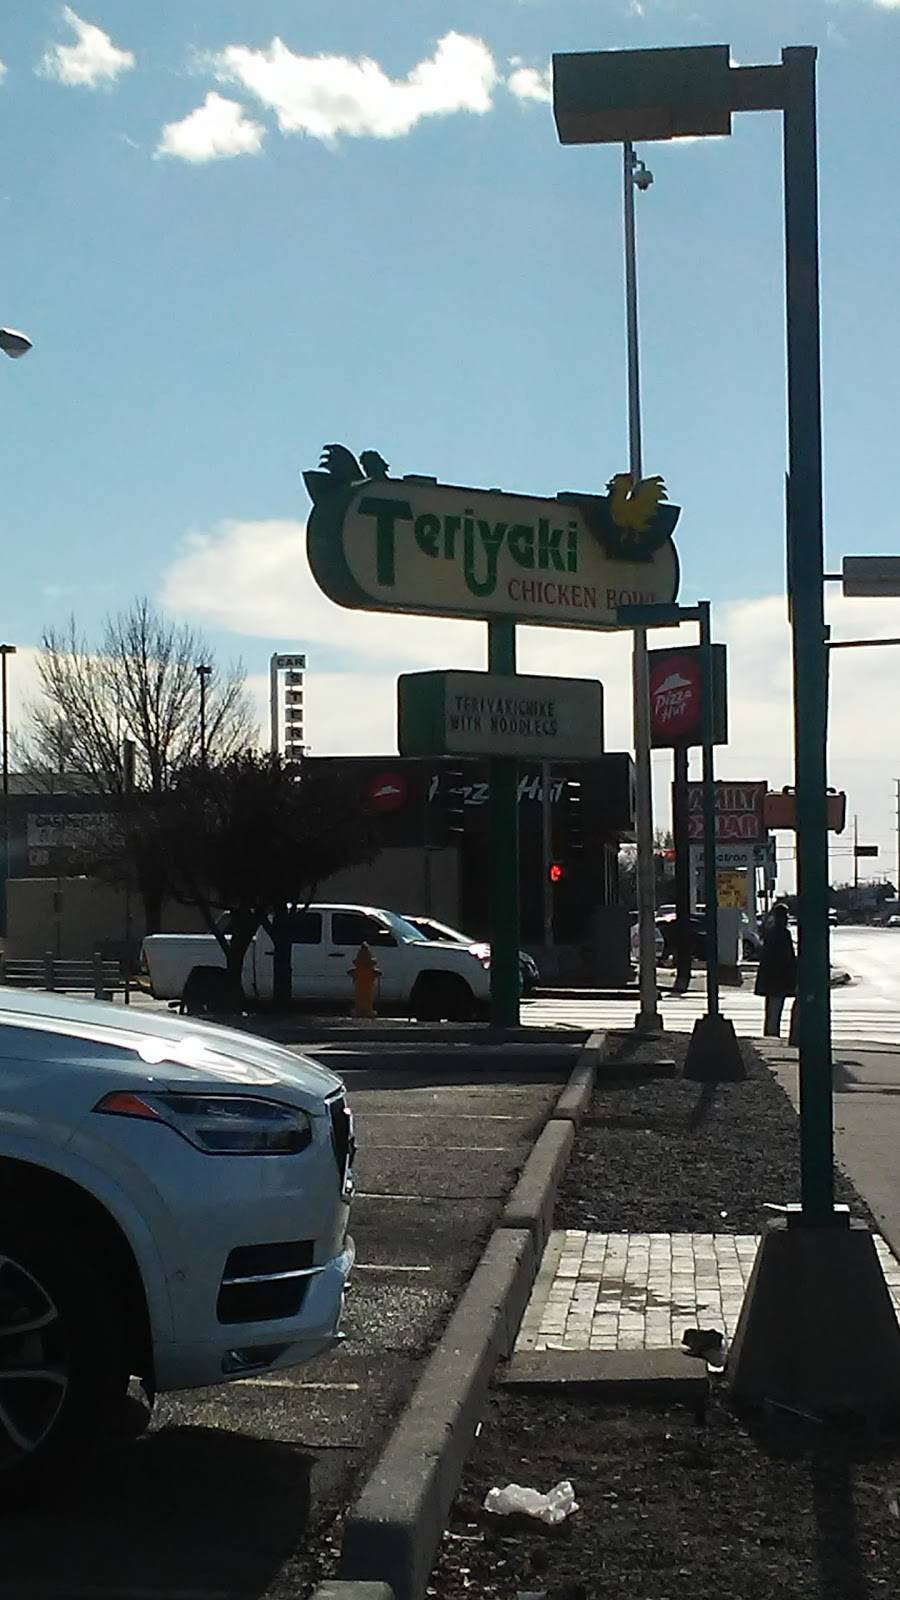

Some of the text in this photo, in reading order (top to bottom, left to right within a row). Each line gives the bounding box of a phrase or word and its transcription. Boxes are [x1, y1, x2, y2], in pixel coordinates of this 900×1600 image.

[358, 497, 578, 598] Teriyaki
[507, 578, 597, 609] CHICKEN
[276, 657, 304, 667] CAR
[655, 690, 692, 715] Pizza
[660, 702, 687, 722] Hut
[449, 714, 481, 733] WITH
